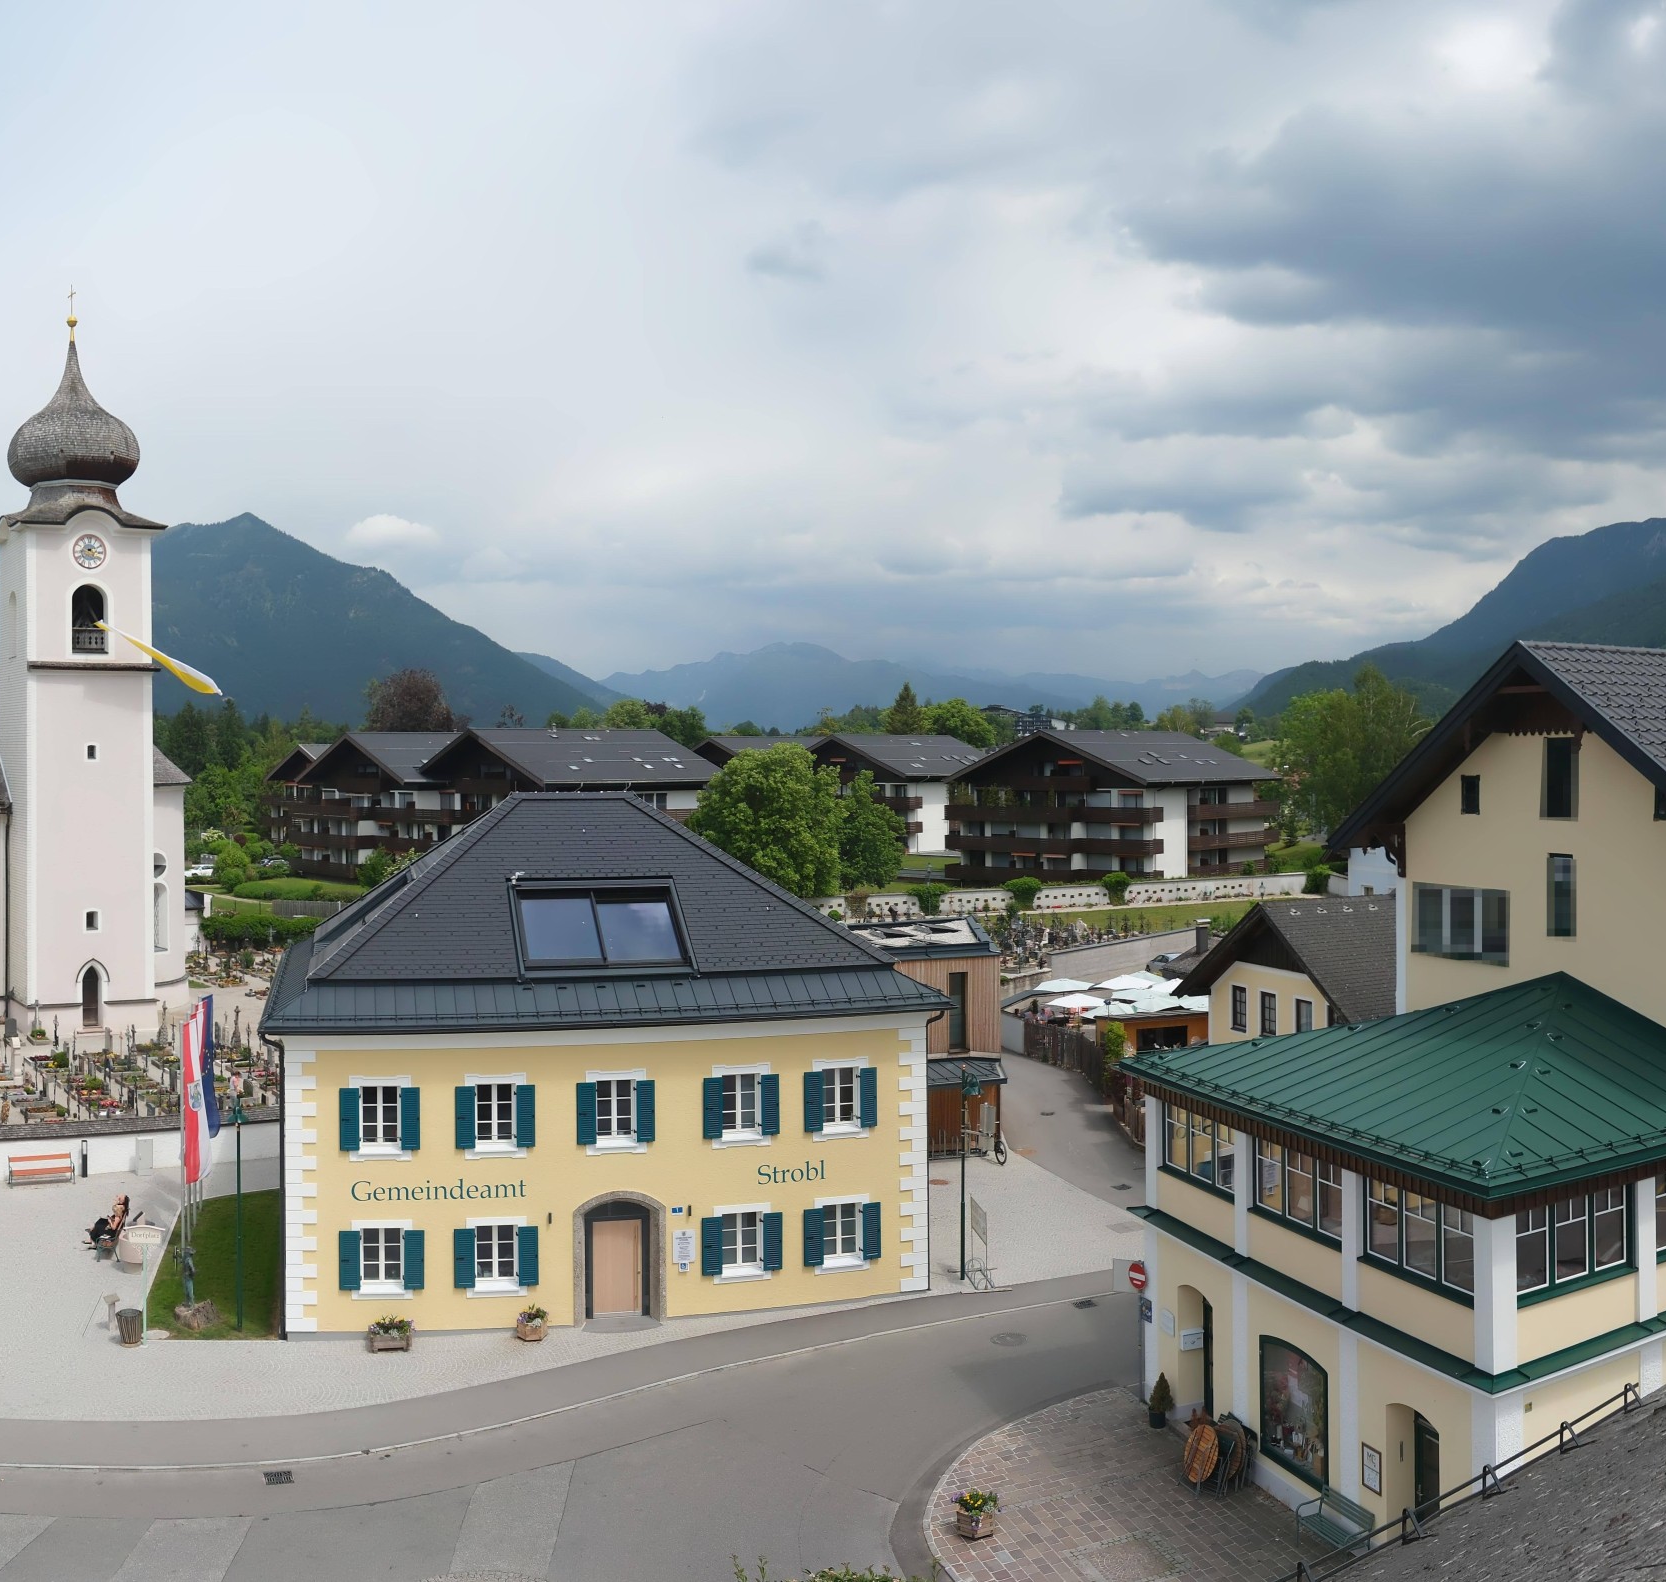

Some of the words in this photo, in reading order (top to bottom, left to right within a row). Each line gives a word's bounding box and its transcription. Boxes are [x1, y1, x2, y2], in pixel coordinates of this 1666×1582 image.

[757, 1159, 826, 1185] Strobl
[351, 1178, 527, 1202] Gemeindeamt
[131, 1231, 160, 1240] Dorfplatz
